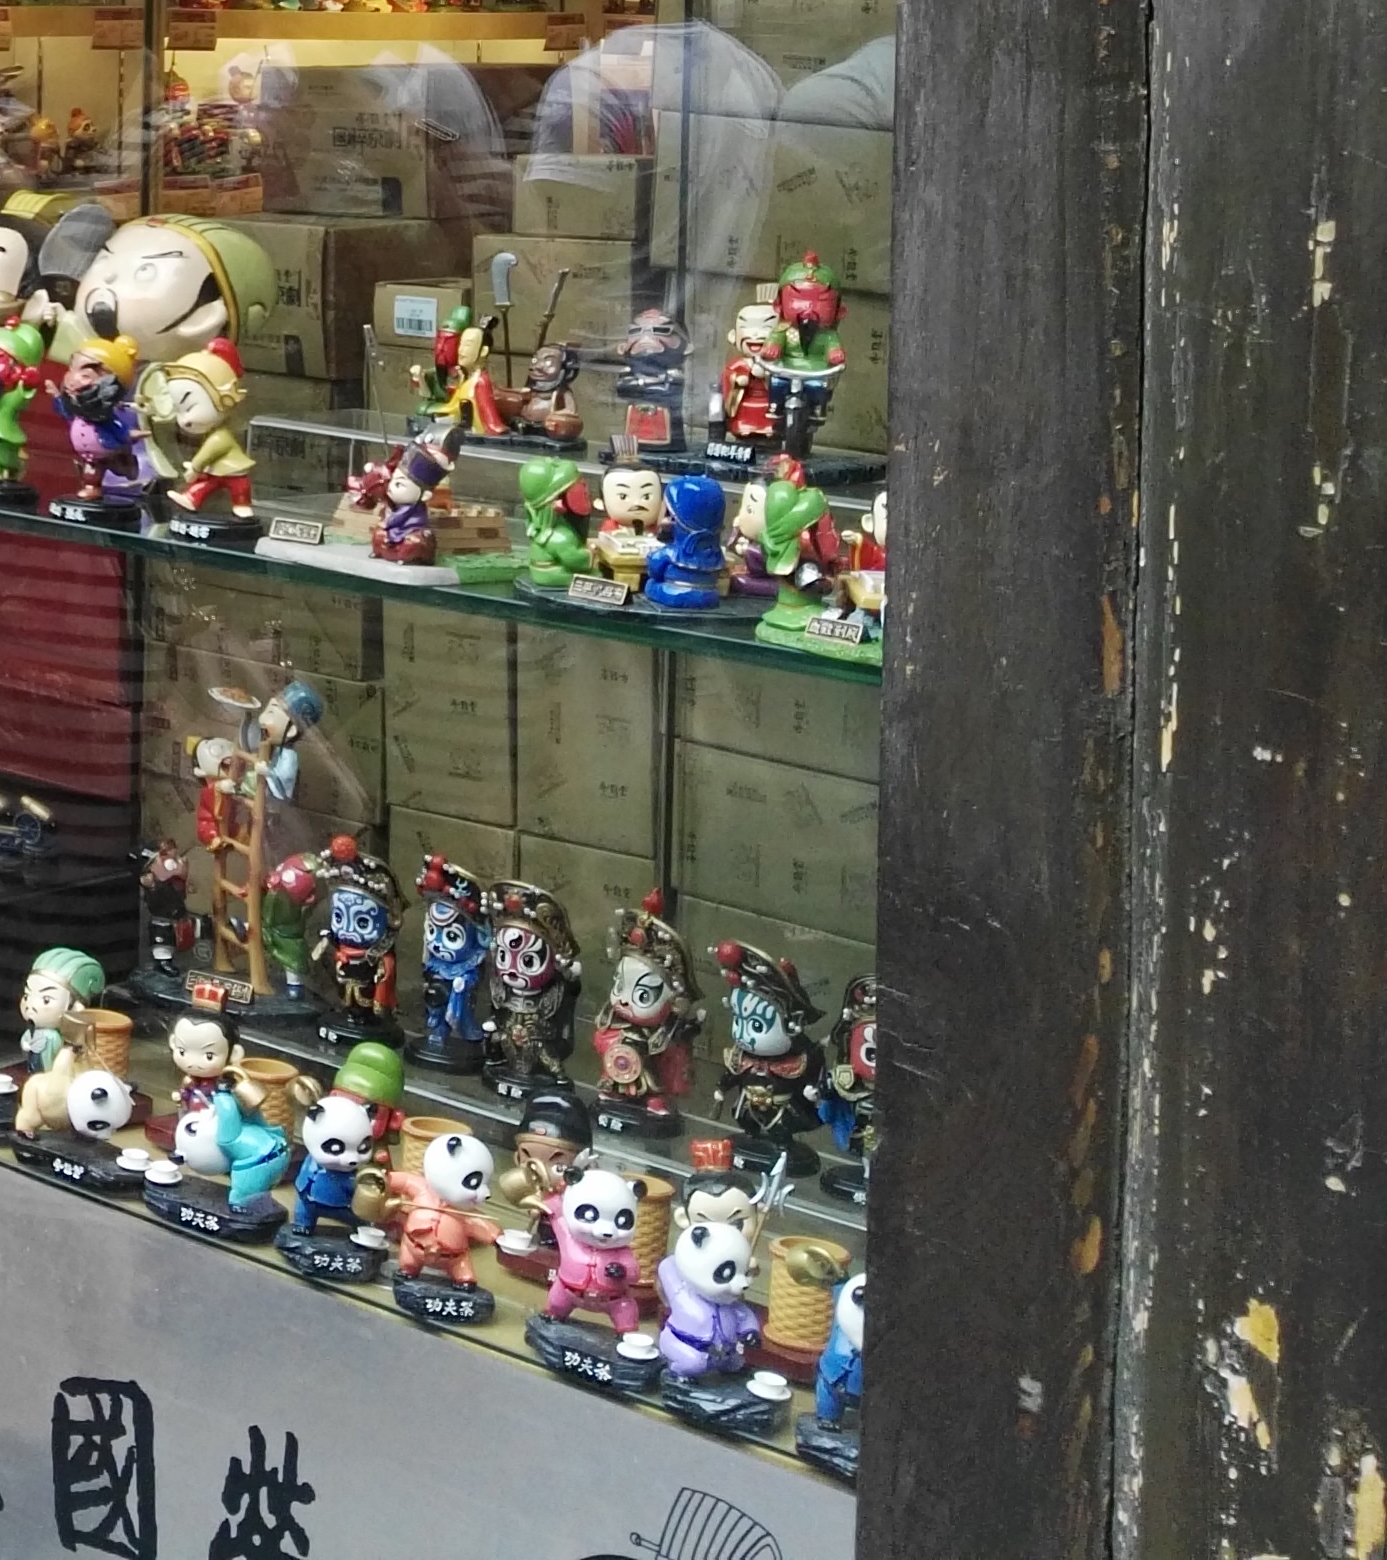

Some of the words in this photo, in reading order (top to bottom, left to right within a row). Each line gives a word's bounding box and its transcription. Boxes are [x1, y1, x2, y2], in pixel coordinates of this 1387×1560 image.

[181, 1206, 220, 1231] 功夫茶
[314, 1253, 362, 1273] 功夫茶
[426, 1298, 475, 1317] 功夫茶
[565, 1351, 613, 1381] 功夫茶
